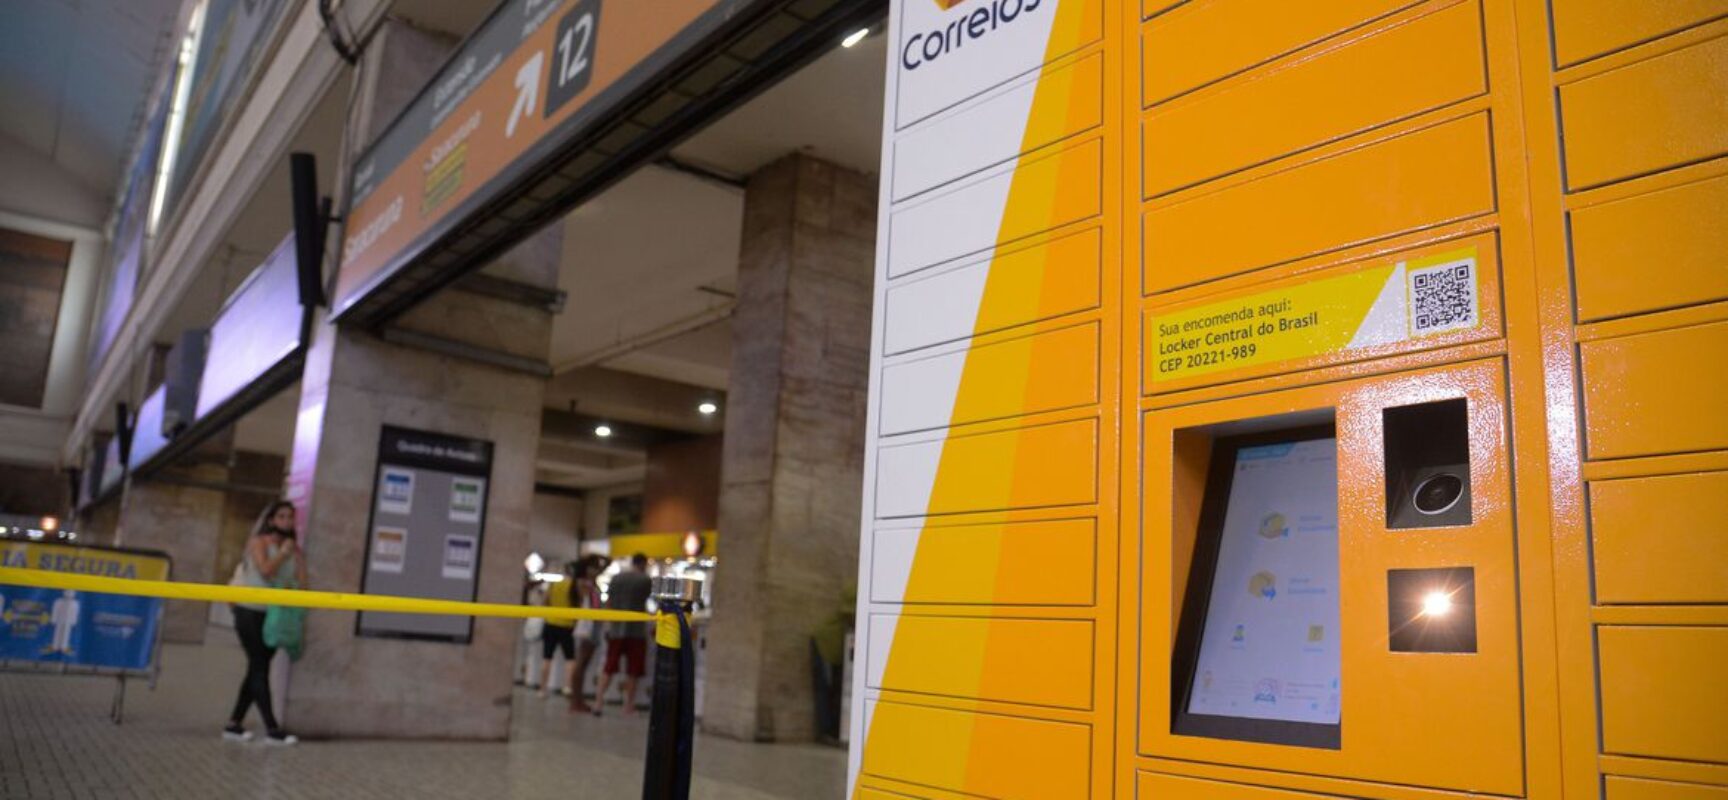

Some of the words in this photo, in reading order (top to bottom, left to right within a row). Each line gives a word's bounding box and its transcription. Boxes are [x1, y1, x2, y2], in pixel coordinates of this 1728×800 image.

[558, 12, 594, 88] 12
[1159, 323, 1180, 338] Sua
[1183, 306, 1254, 332] encomenda
[1258, 298, 1292, 318] aqui:
[1159, 337, 1201, 355] Locker
[1205, 324, 1253, 346] Central
[1257, 322, 1274, 336] do
[1279, 311, 1319, 331] Brasil
[1159, 357, 1183, 373] CEP
[1187, 343, 1257, 369] 20221-989
[38, 553, 138, 579] SEGURA
